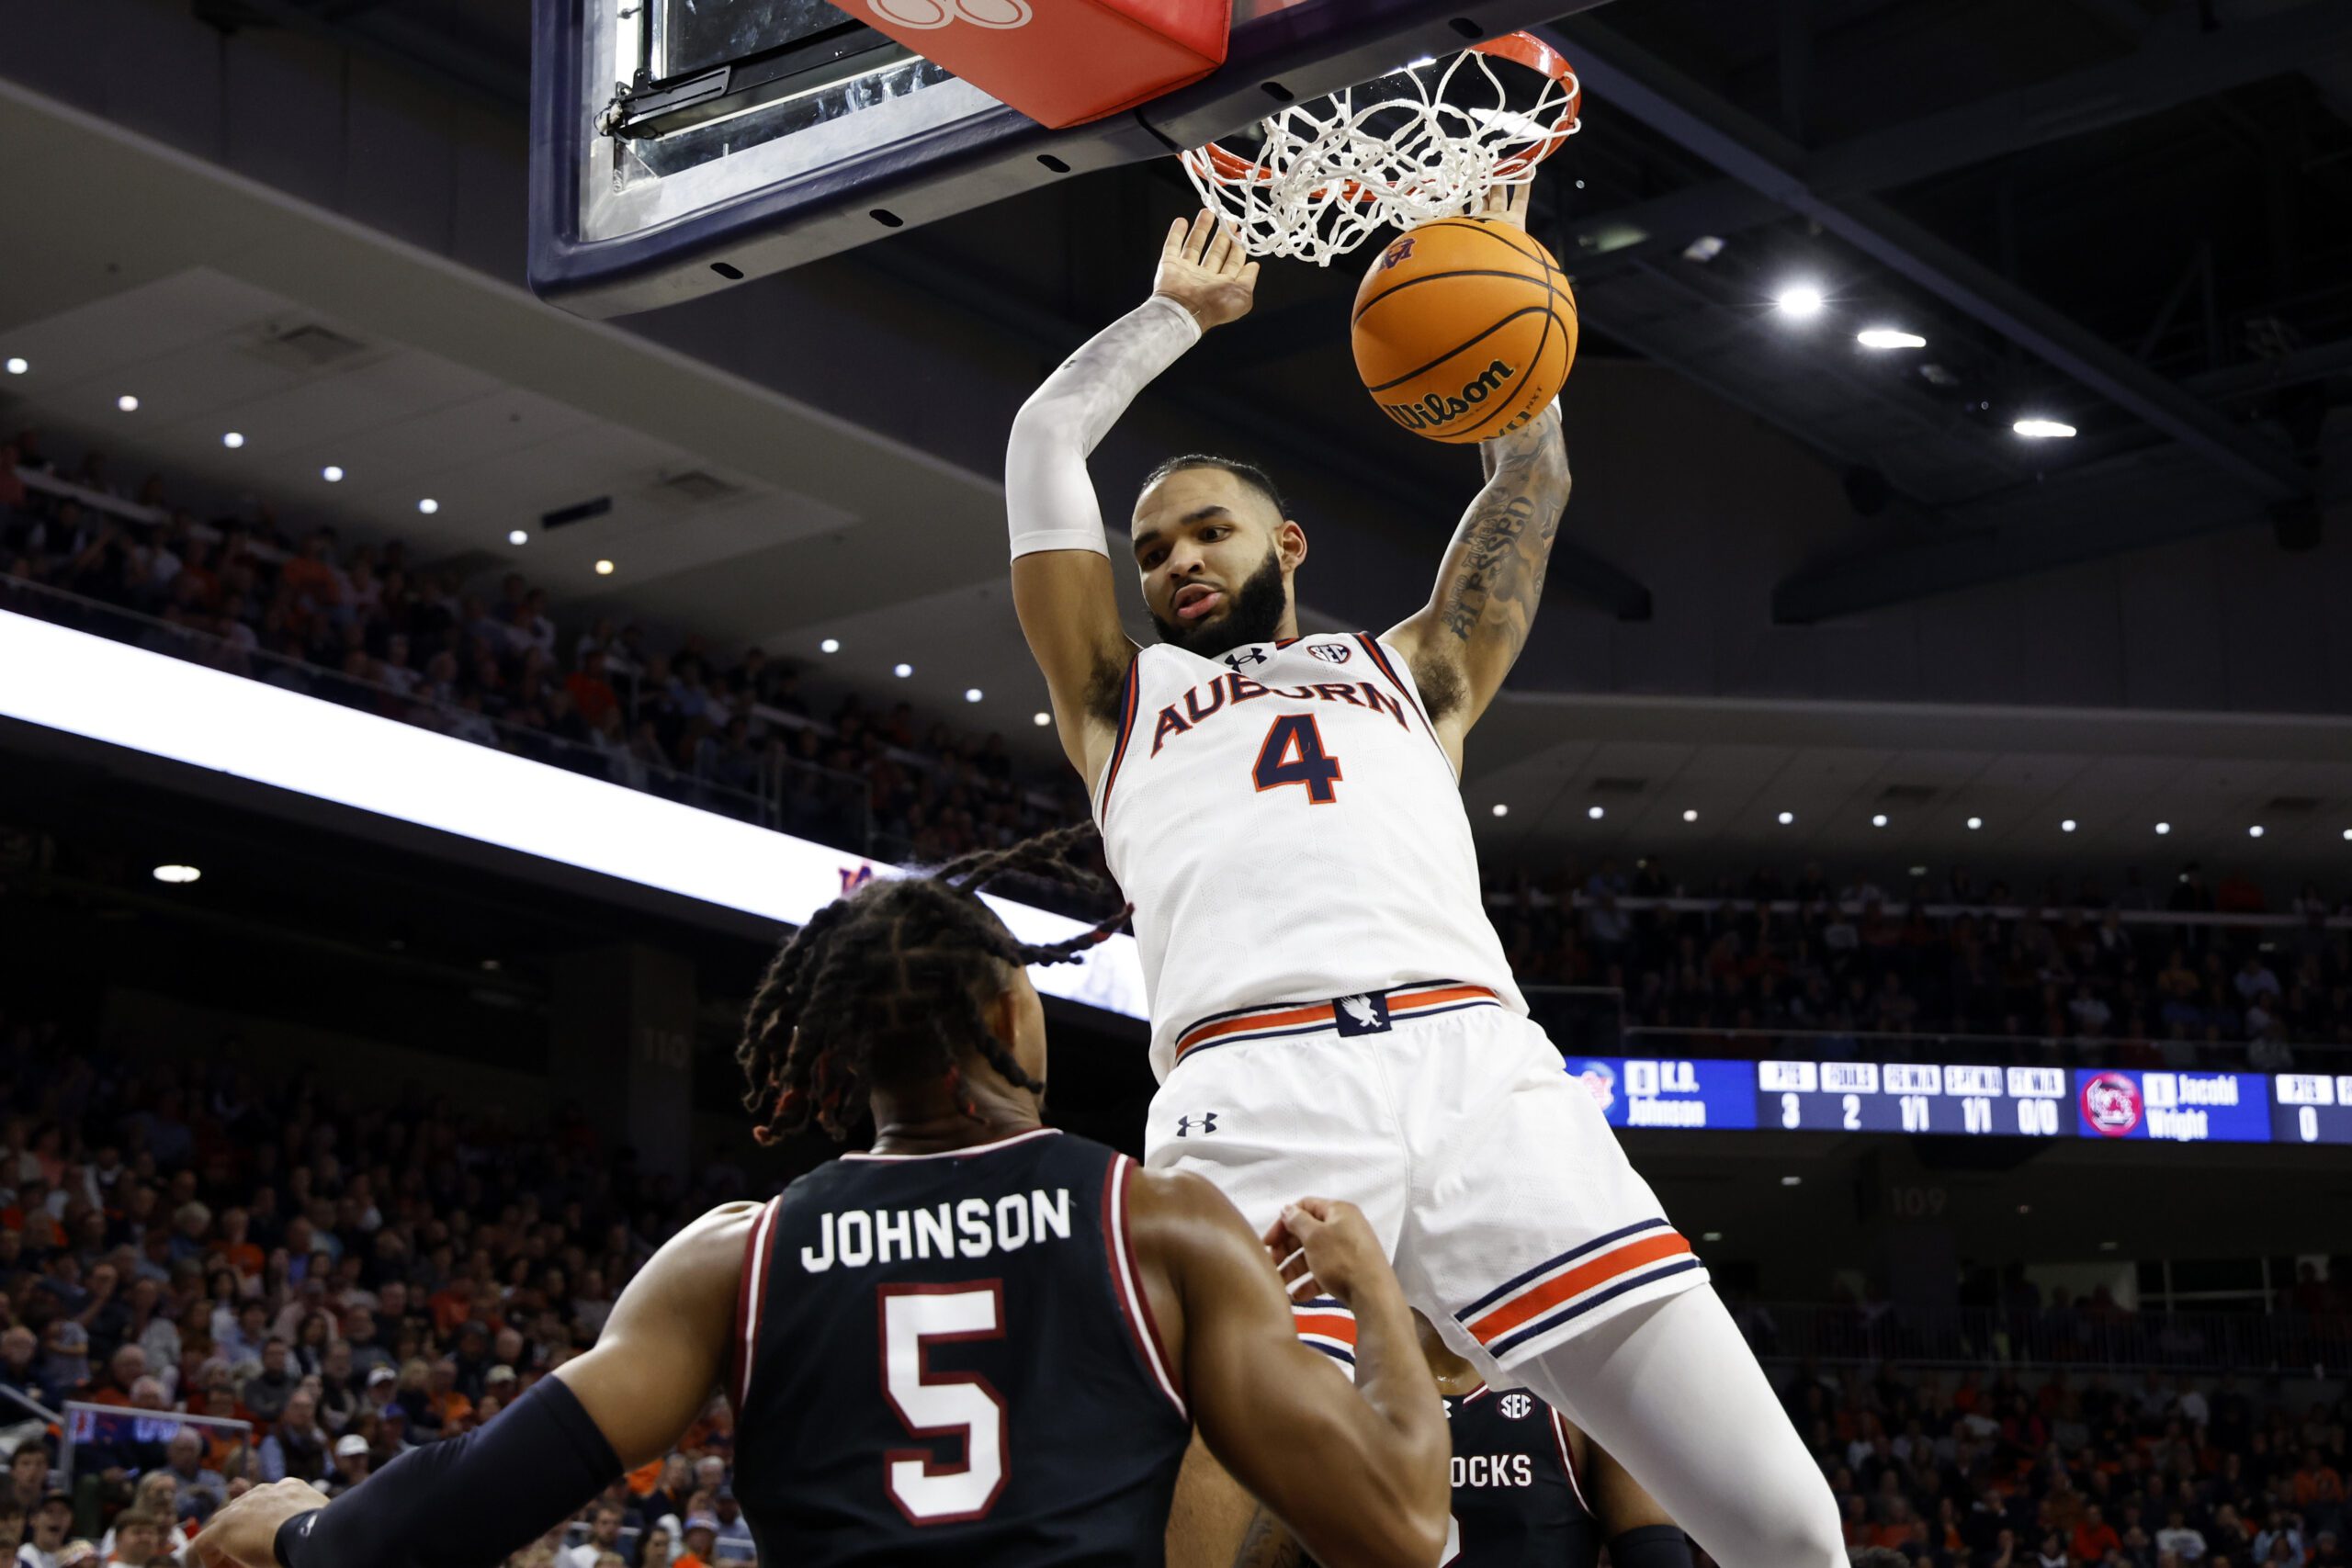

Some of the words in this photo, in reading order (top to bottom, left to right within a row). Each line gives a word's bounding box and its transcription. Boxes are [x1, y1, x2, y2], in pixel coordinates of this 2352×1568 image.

[1382, 358, 1515, 429] Wilson
[1450, 496, 1535, 640] BLESSED
[1308, 644, 1349, 662] SEC
[1150, 672, 1410, 760] AUBURN
[1251, 712, 1343, 805] 4
[1781, 1093, 1800, 1128] 3
[1843, 1094, 1861, 1130] 2
[2299, 1106, 2318, 1142] 0
[801, 1188, 1071, 1273] JOHNSON
[876, 1278, 1011, 1527] 5
[1500, 1393, 1533, 1419] SEC
[1450, 1454, 1532, 1487] OCKS
